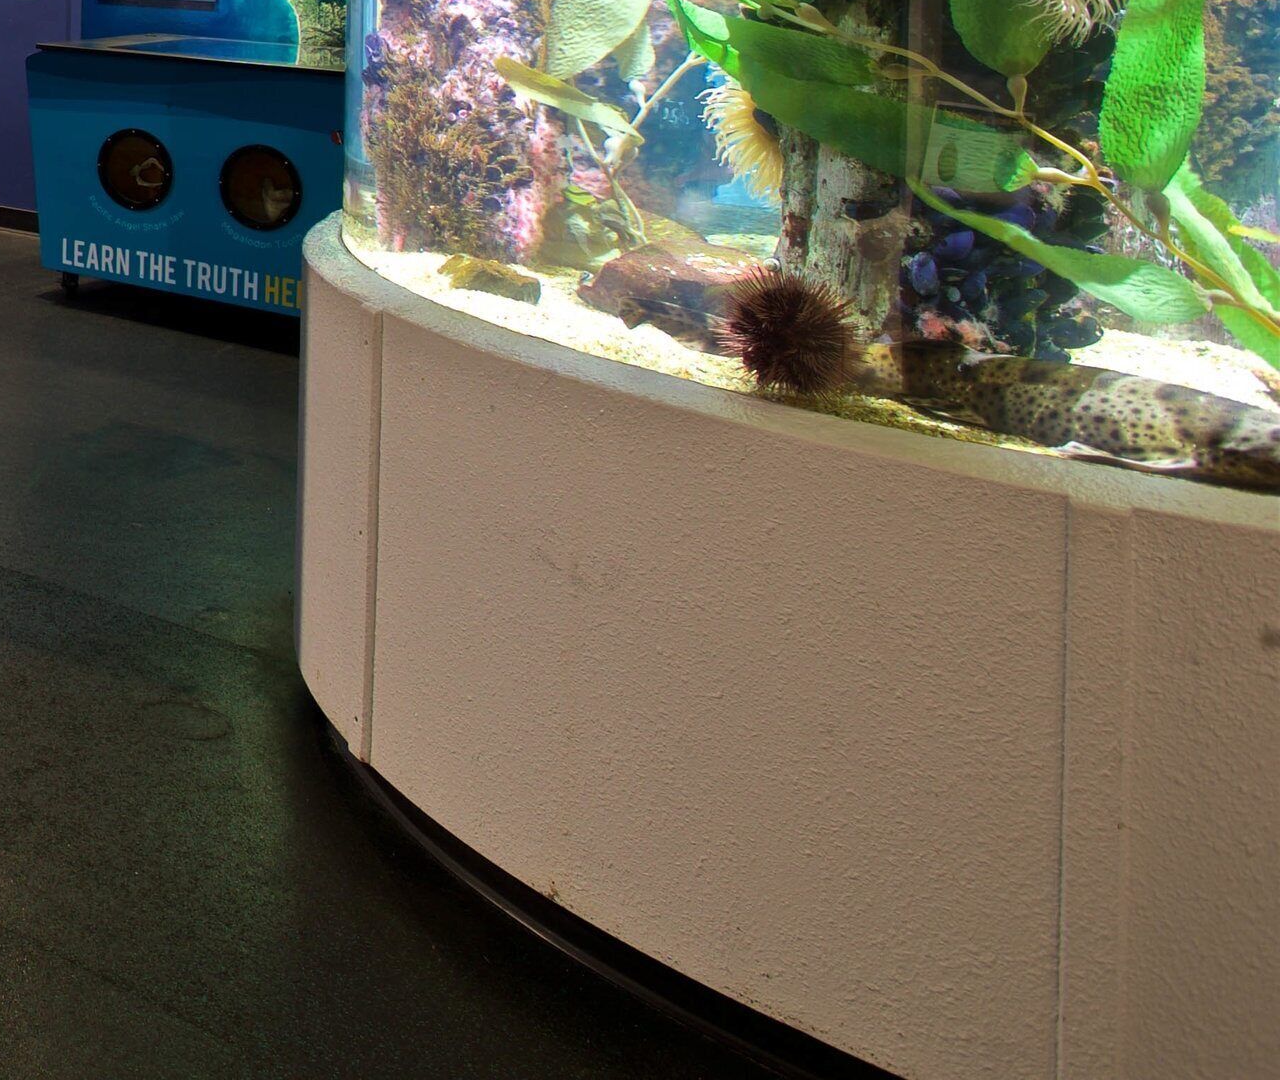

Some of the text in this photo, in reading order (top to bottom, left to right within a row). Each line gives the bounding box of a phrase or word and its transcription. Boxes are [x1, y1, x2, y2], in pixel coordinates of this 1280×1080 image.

[62, 237, 130, 276] LEARN
[136, 250, 177, 285] THE
[183, 258, 259, 301] TRUTH
